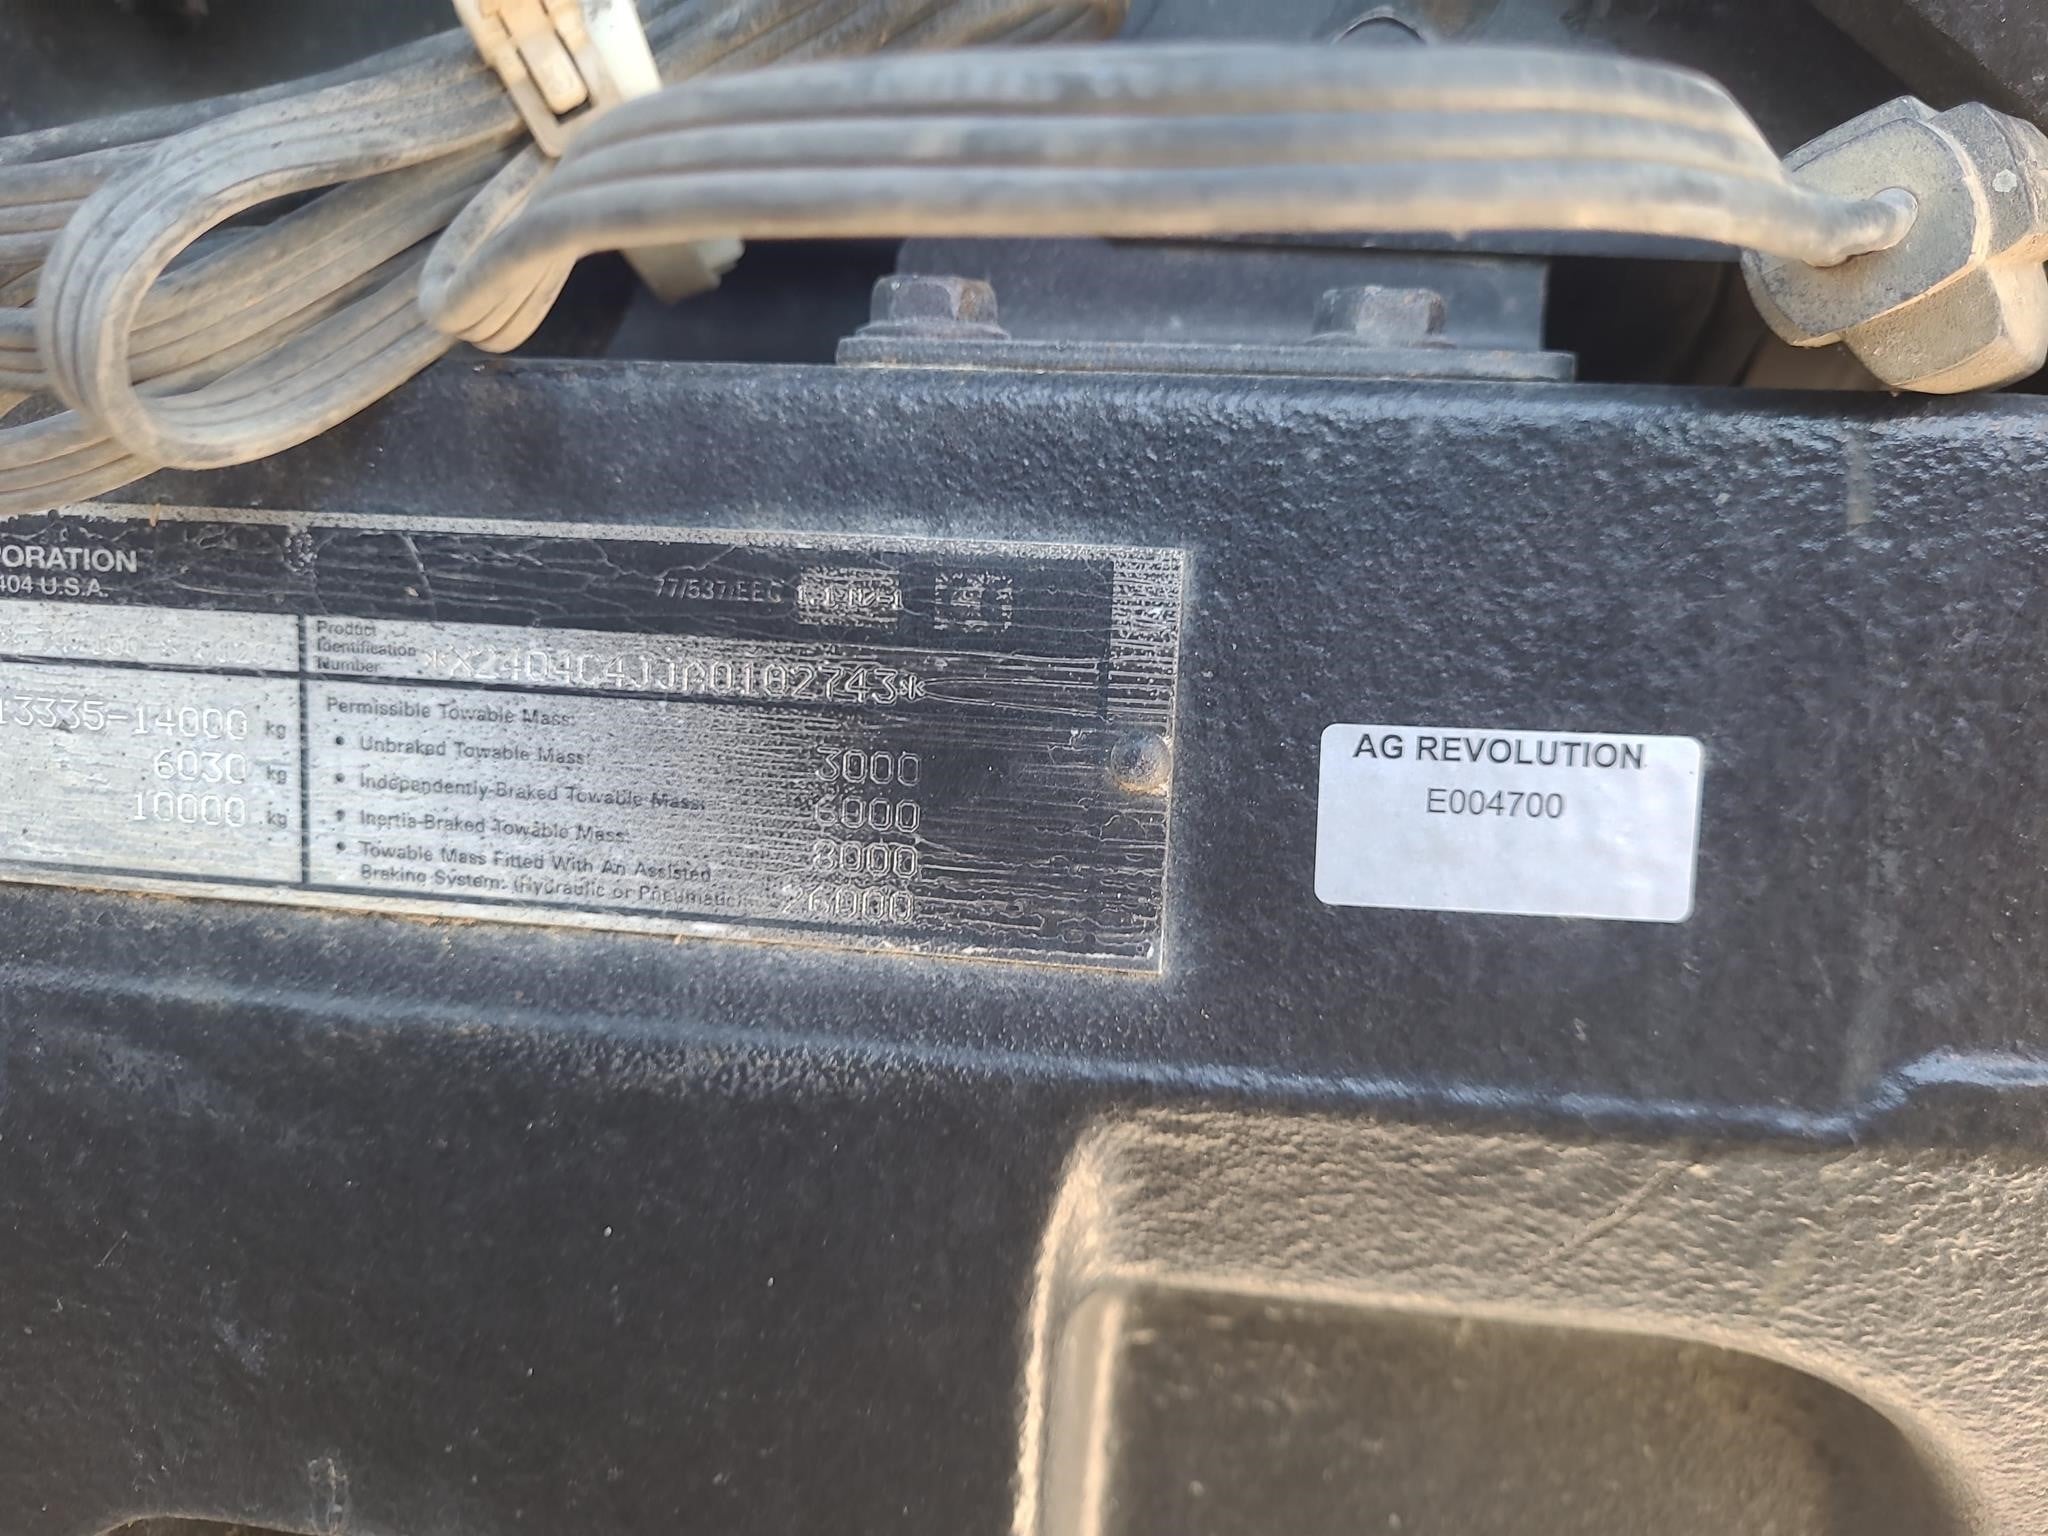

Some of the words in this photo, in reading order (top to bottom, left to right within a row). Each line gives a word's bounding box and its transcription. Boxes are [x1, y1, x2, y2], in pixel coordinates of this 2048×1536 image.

[0, 545, 137, 572] ORATION
[40, 576, 109, 597] U.S.A.
[316, 620, 376, 637] Product
[316, 637, 416, 657] Identification
[316, 656, 380, 673] Number
[326, 696, 431, 718] Permissible
[438, 703, 515, 724] Towable
[265, 720, 286, 739] kg
[360, 735, 446, 756] Unbraked
[454, 741, 529, 762] Towable
[816, 746, 922, 787] 3000
[1353, 733, 1403, 760] AG
[1416, 735, 1645, 770] REVOLUTION
[154, 750, 247, 784] 6030
[266, 766, 287, 784] kg
[360, 772, 558, 801] Independently-Braked
[566, 786, 643, 808] Towable
[1426, 787, 1565, 819] E004700
[134, 791, 246, 827] 10000
[267, 810, 287, 829] kg
[360, 810, 485, 834] Inertia-Braked
[491, 817, 569, 839] Towable
[359, 840, 433, 862] Towable
[441, 847, 487, 866] Mass
[494, 850, 544, 870] Fitted
[552, 855, 593, 874] With
[602, 860, 627, 877] An
[361, 864, 427, 886] Braking
[613, 886, 631, 899] or
